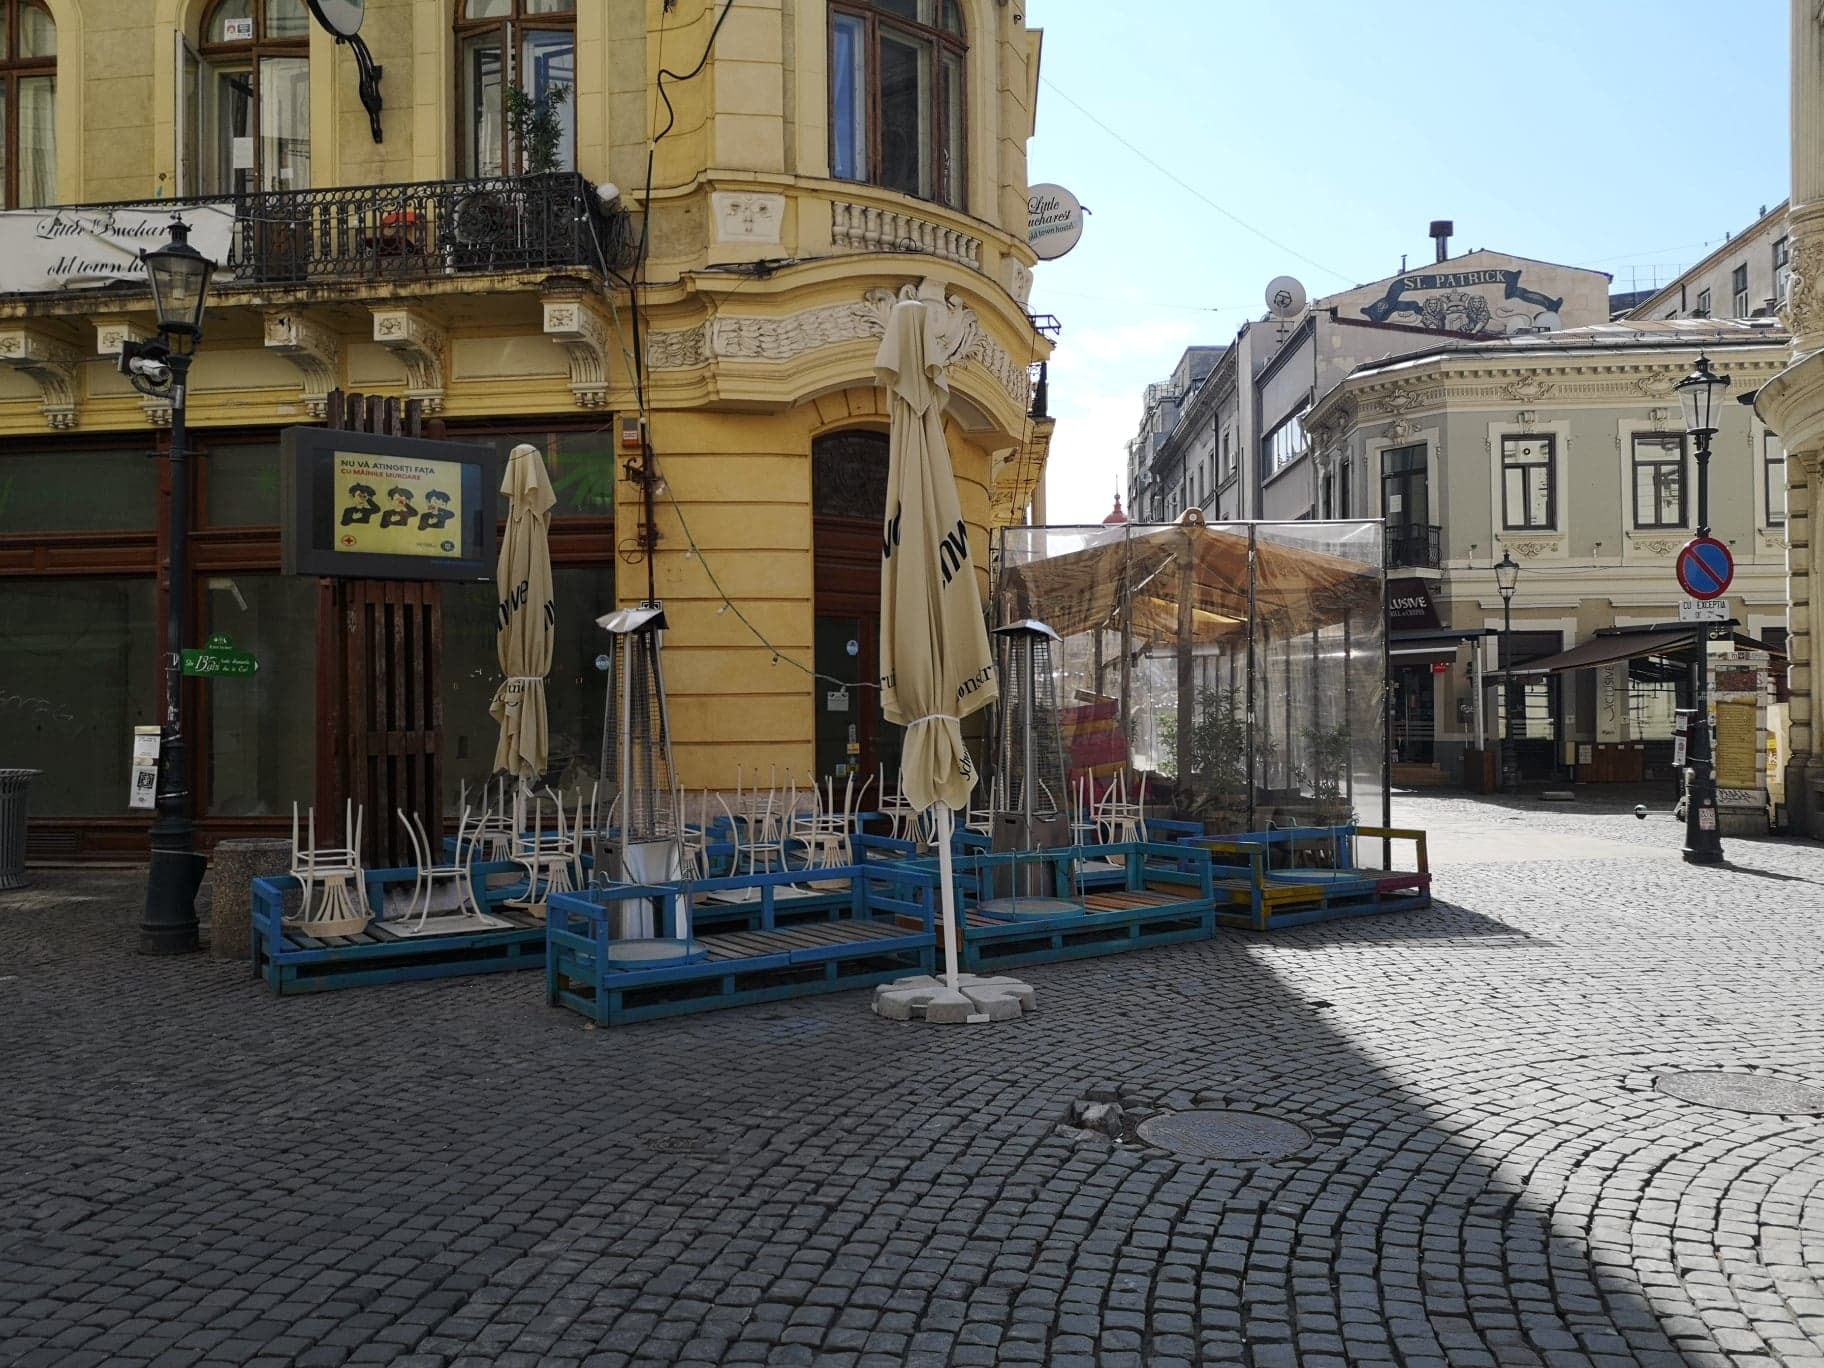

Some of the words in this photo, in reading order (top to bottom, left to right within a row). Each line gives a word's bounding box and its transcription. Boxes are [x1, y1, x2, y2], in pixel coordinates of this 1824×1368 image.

[1028, 195, 1060, 214] Little
[36, 210, 86, 240] Little
[1028, 210, 1072, 227] ucharest
[47, 256, 78, 276] old
[77, 259, 125, 275] town
[1404, 277, 1426, 290] ST.
[1436, 270, 1506, 287] PATRICK
